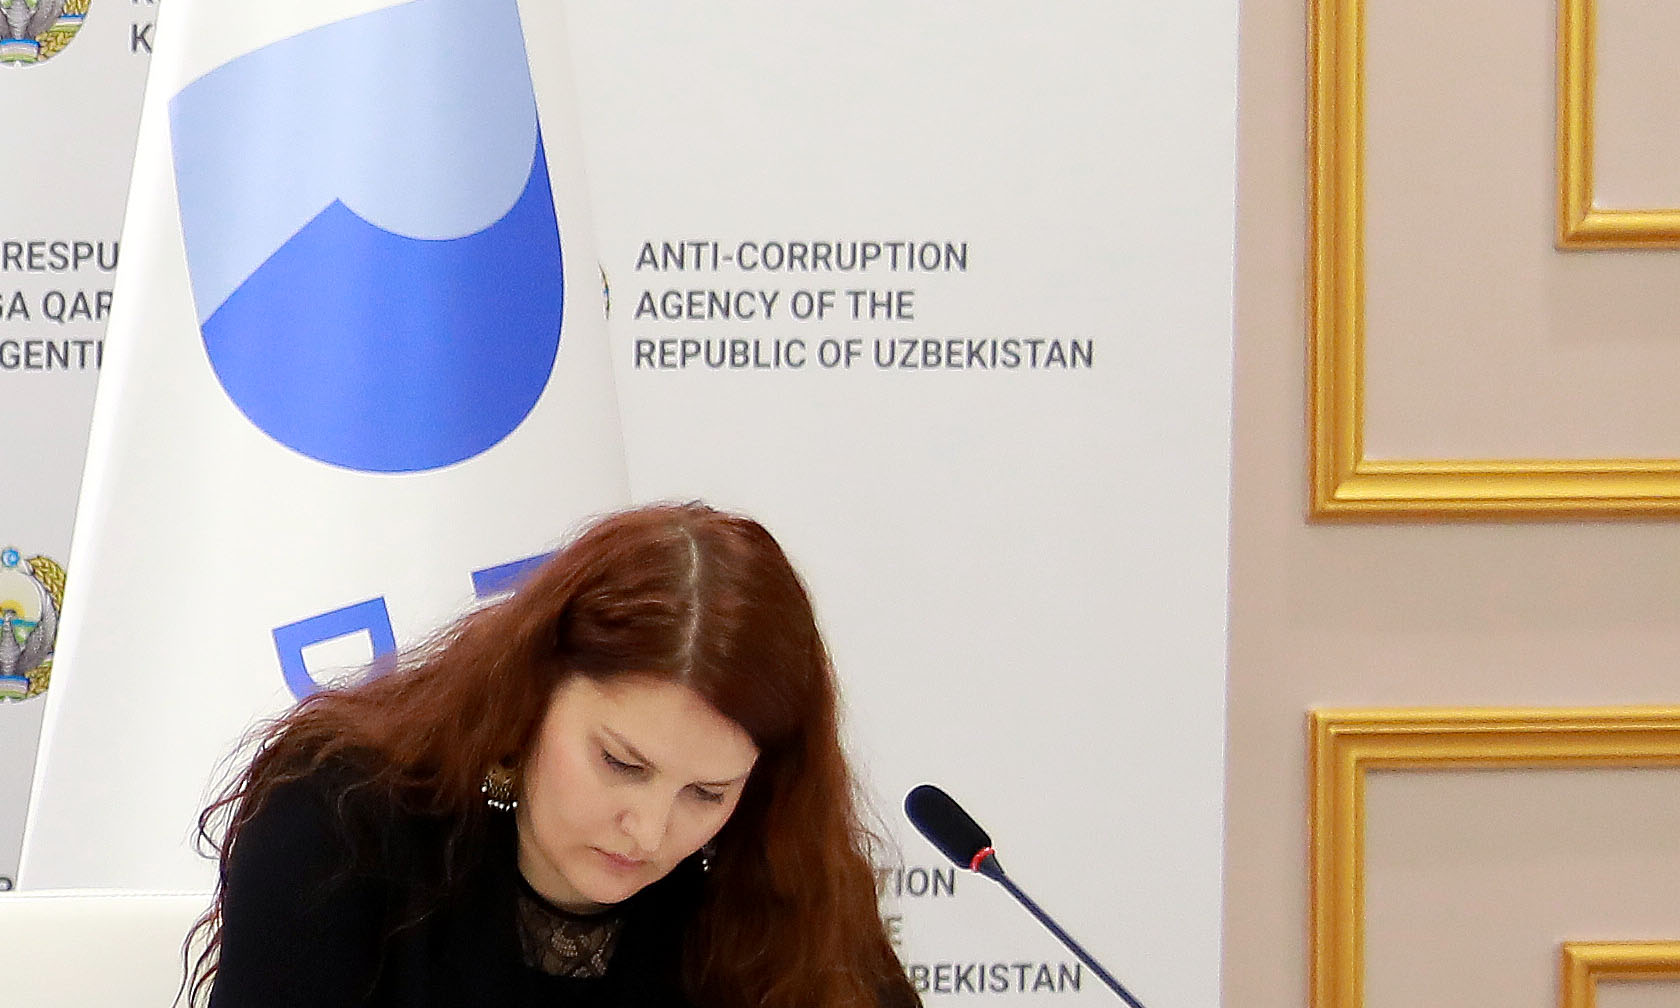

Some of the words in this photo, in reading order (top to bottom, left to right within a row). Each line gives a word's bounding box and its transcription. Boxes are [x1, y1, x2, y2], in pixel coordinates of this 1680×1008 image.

[635, 239, 968, 273] ANTI-CORRUPTION
[634, 288, 781, 321] AGENCY
[790, 289, 836, 321] OF
[845, 289, 915, 321] THE
[634, 337, 807, 370] REPUBLIC
[817, 338, 863, 370] OF
[874, 337, 1094, 370] UZBEKISTAN
